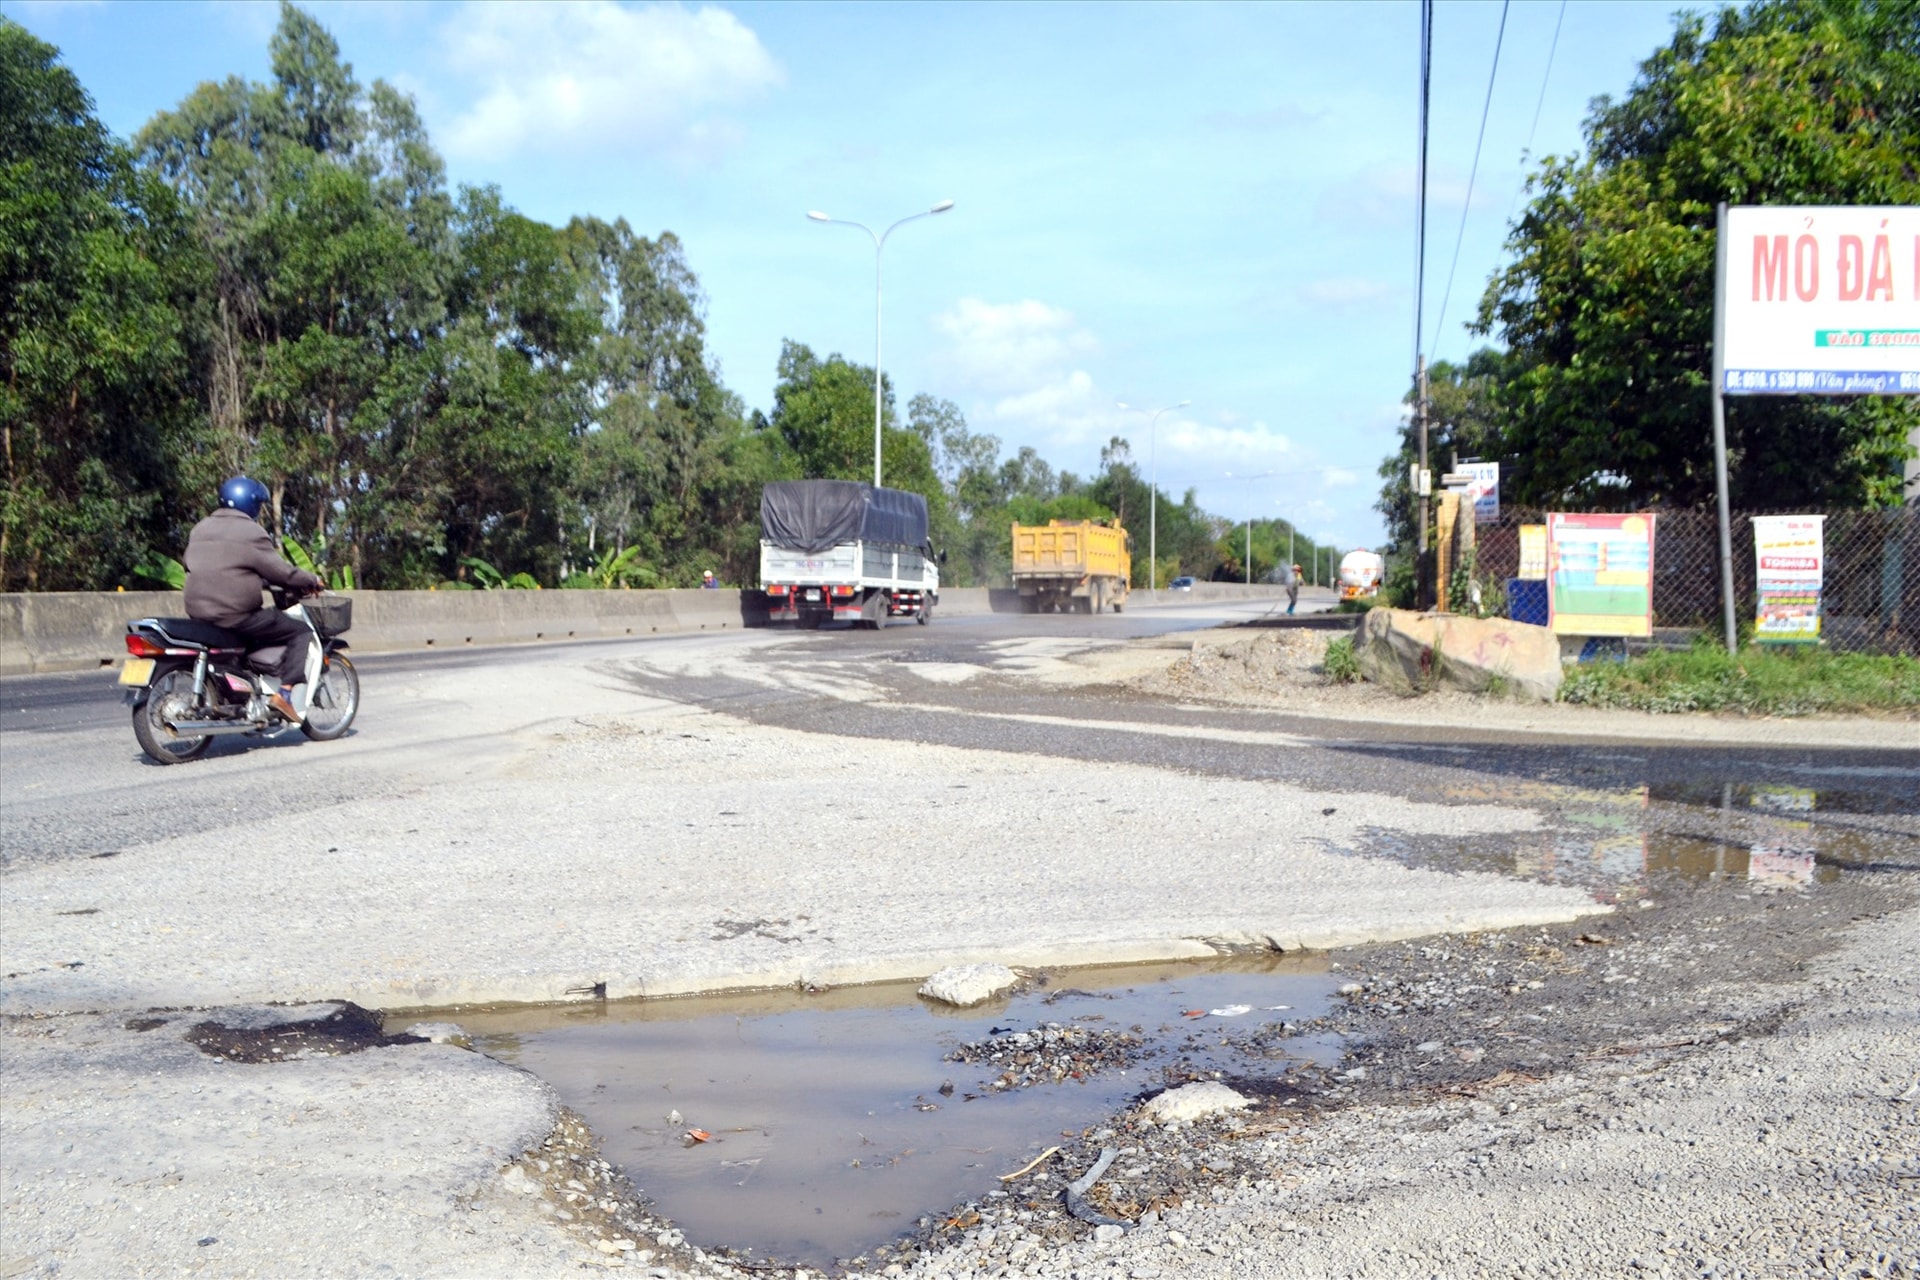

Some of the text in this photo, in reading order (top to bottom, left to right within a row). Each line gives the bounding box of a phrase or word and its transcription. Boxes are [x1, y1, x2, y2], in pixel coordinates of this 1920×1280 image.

[1752, 216, 1819, 303] MỎ
[1836, 218, 1894, 302] ĐÁ
[1765, 558, 1814, 568] TOSHIBA
